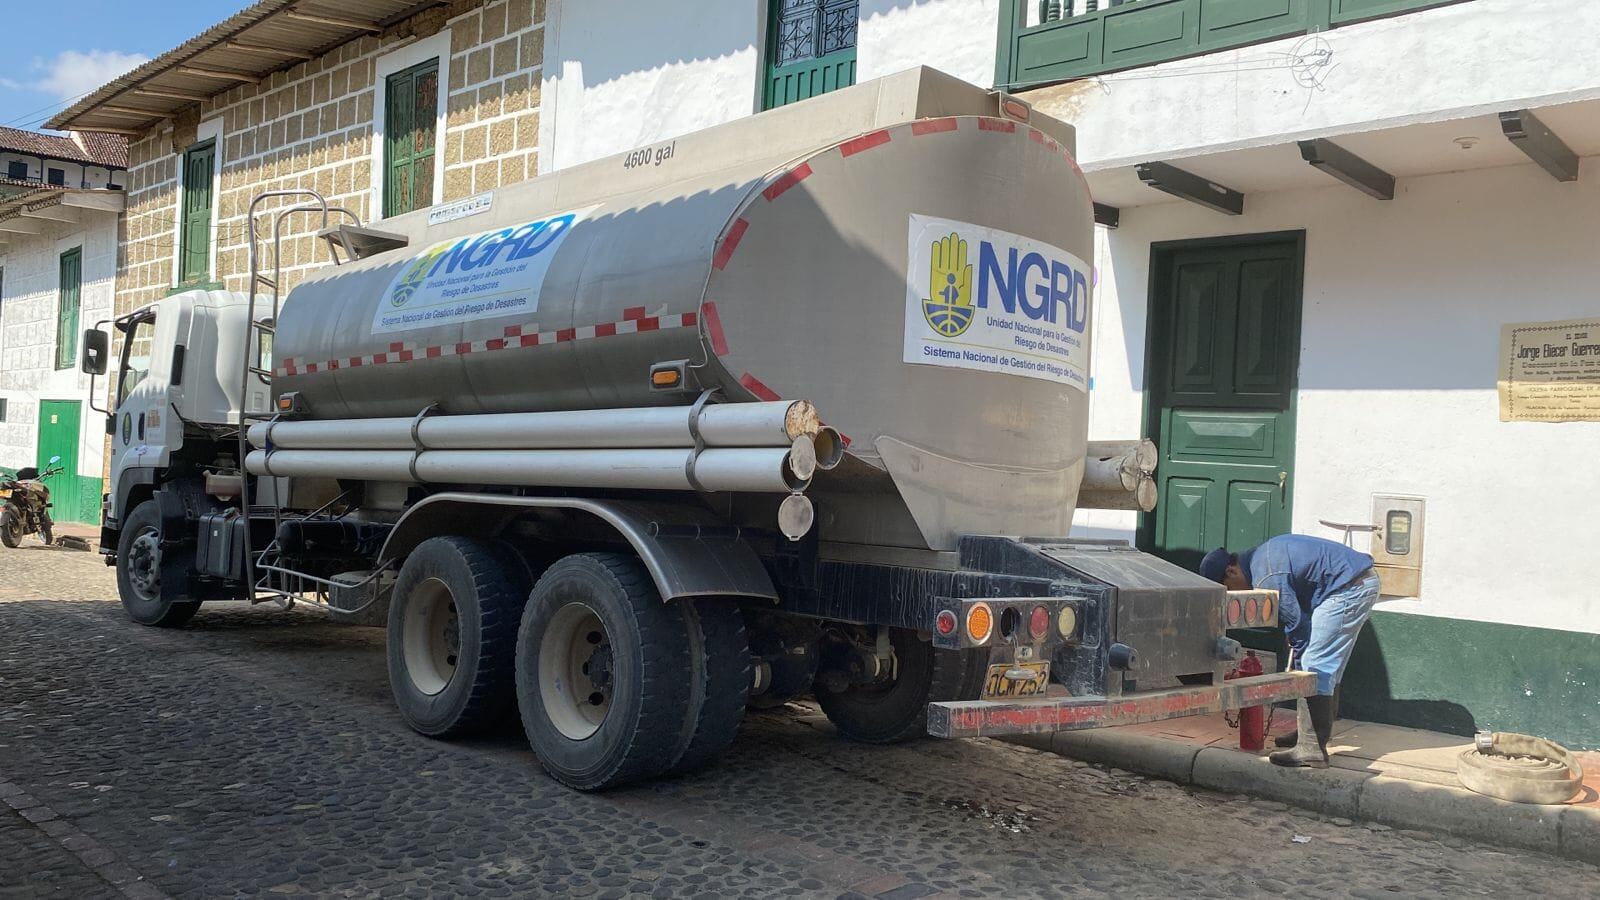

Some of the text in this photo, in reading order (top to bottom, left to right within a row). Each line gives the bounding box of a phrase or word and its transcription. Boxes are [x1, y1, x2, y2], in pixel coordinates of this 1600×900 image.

[624, 140, 676, 169] 4600 gal
[427, 214, 576, 278] NGRD
[441, 287, 461, 298] Riesgo
[470, 281, 499, 294] Desastres
[470, 272, 484, 283] para
[977, 240, 1087, 334] NGRD
[401, 312, 424, 325] Nacional
[464, 304, 485, 317] Riesgo
[494, 297, 527, 310] Desastres
[986, 316, 1013, 330] Unidad
[1014, 322, 1042, 336] Nacional
[1042, 329, 1054, 340] para
[1014, 335, 1036, 350] Riesgo
[1037, 340, 1046, 351] de
[1517, 345, 1540, 361] Jorge
[924, 345, 960, 360] Sistema
[962, 350, 998, 365] Nacional
[999, 355, 1009, 366] de
[1010, 357, 1036, 372] Gestión
[1036, 361, 1046, 372] del
[1046, 363, 1064, 377] Riesgo
